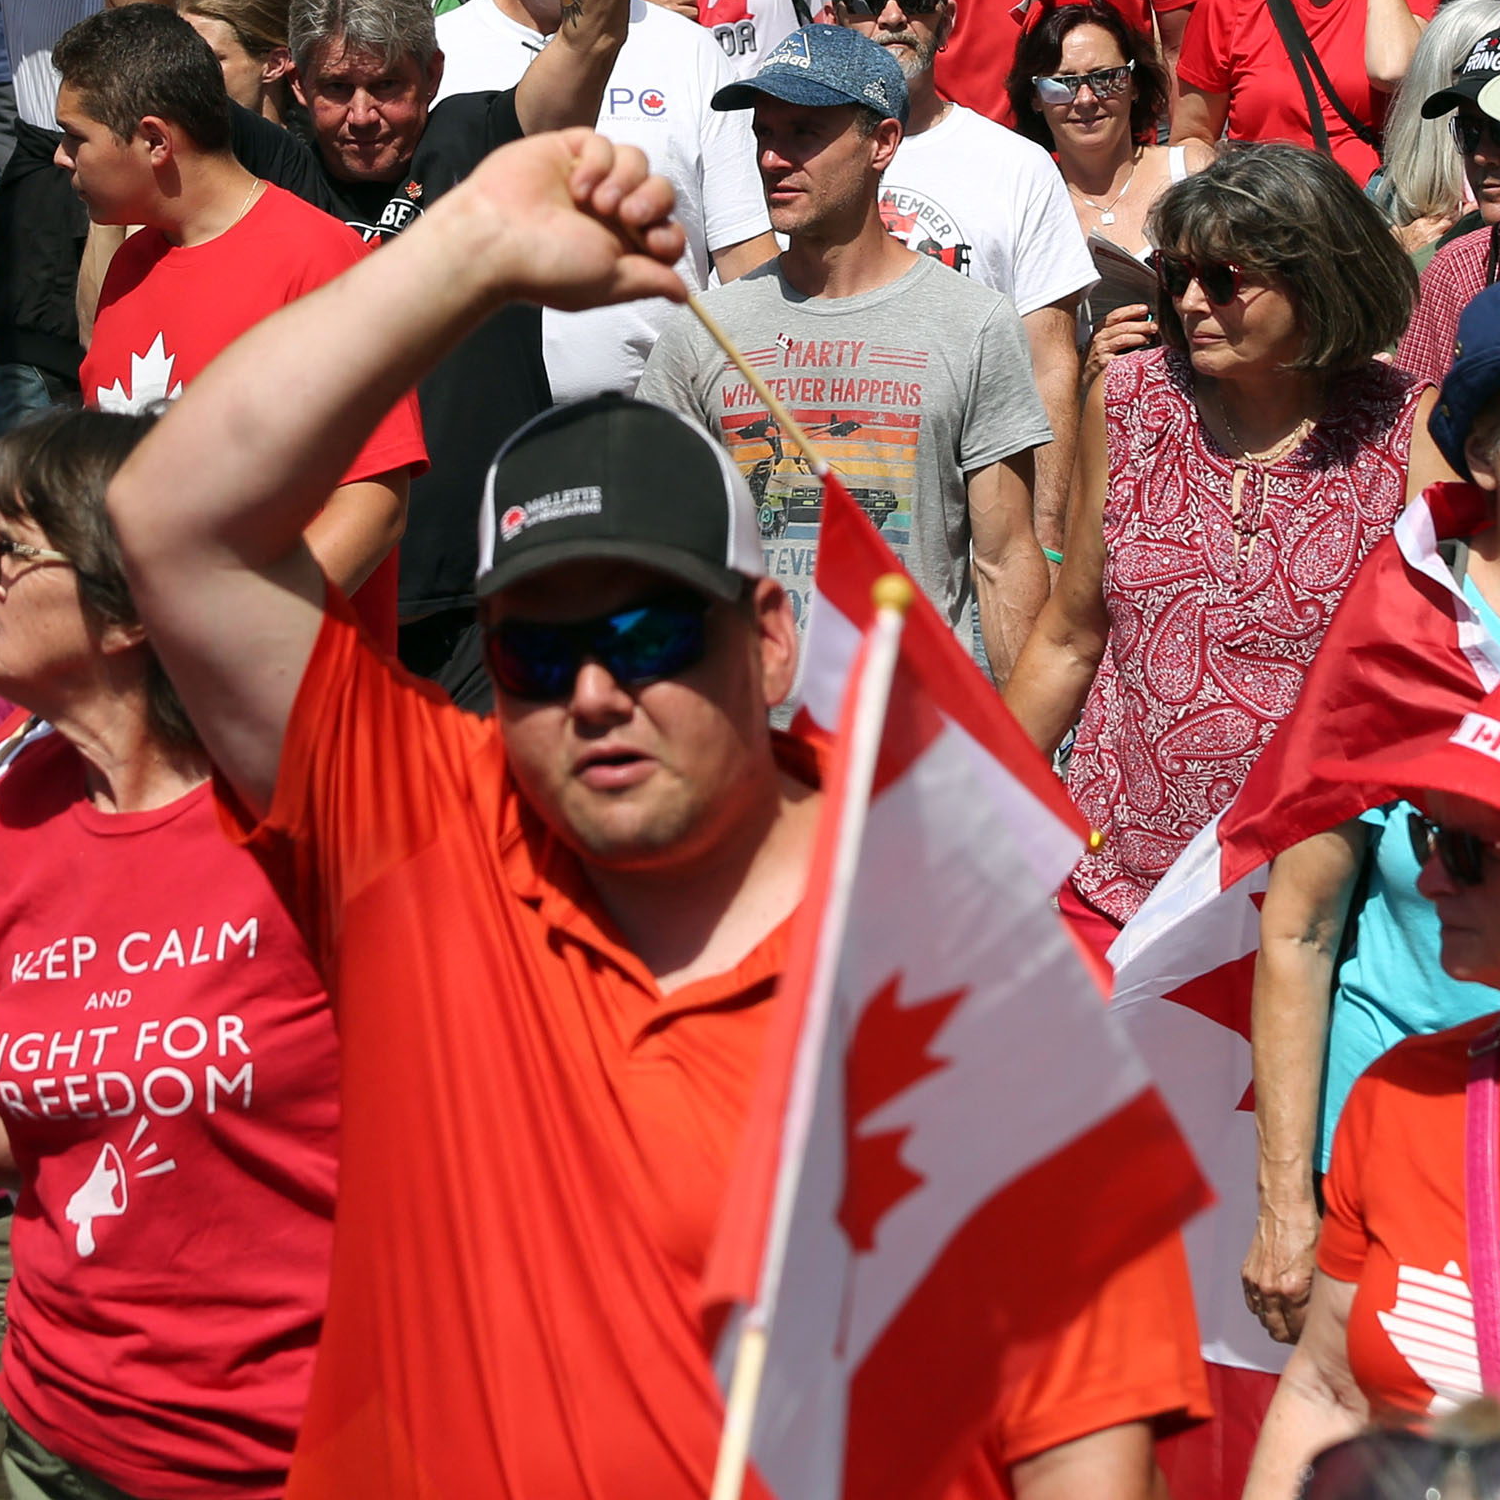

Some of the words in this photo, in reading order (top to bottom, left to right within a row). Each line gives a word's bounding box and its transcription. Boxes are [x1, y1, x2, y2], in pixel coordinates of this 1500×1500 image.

[883, 192, 952, 239] MEMBER
[783, 340, 865, 368] MARTY
[829, 378, 923, 407] HAPPENS
[11, 935, 98, 984] KEEP
[117, 916, 258, 975] CALM
[84, 988, 132, 1011] AND
[133, 1014, 251, 1063] FOR
